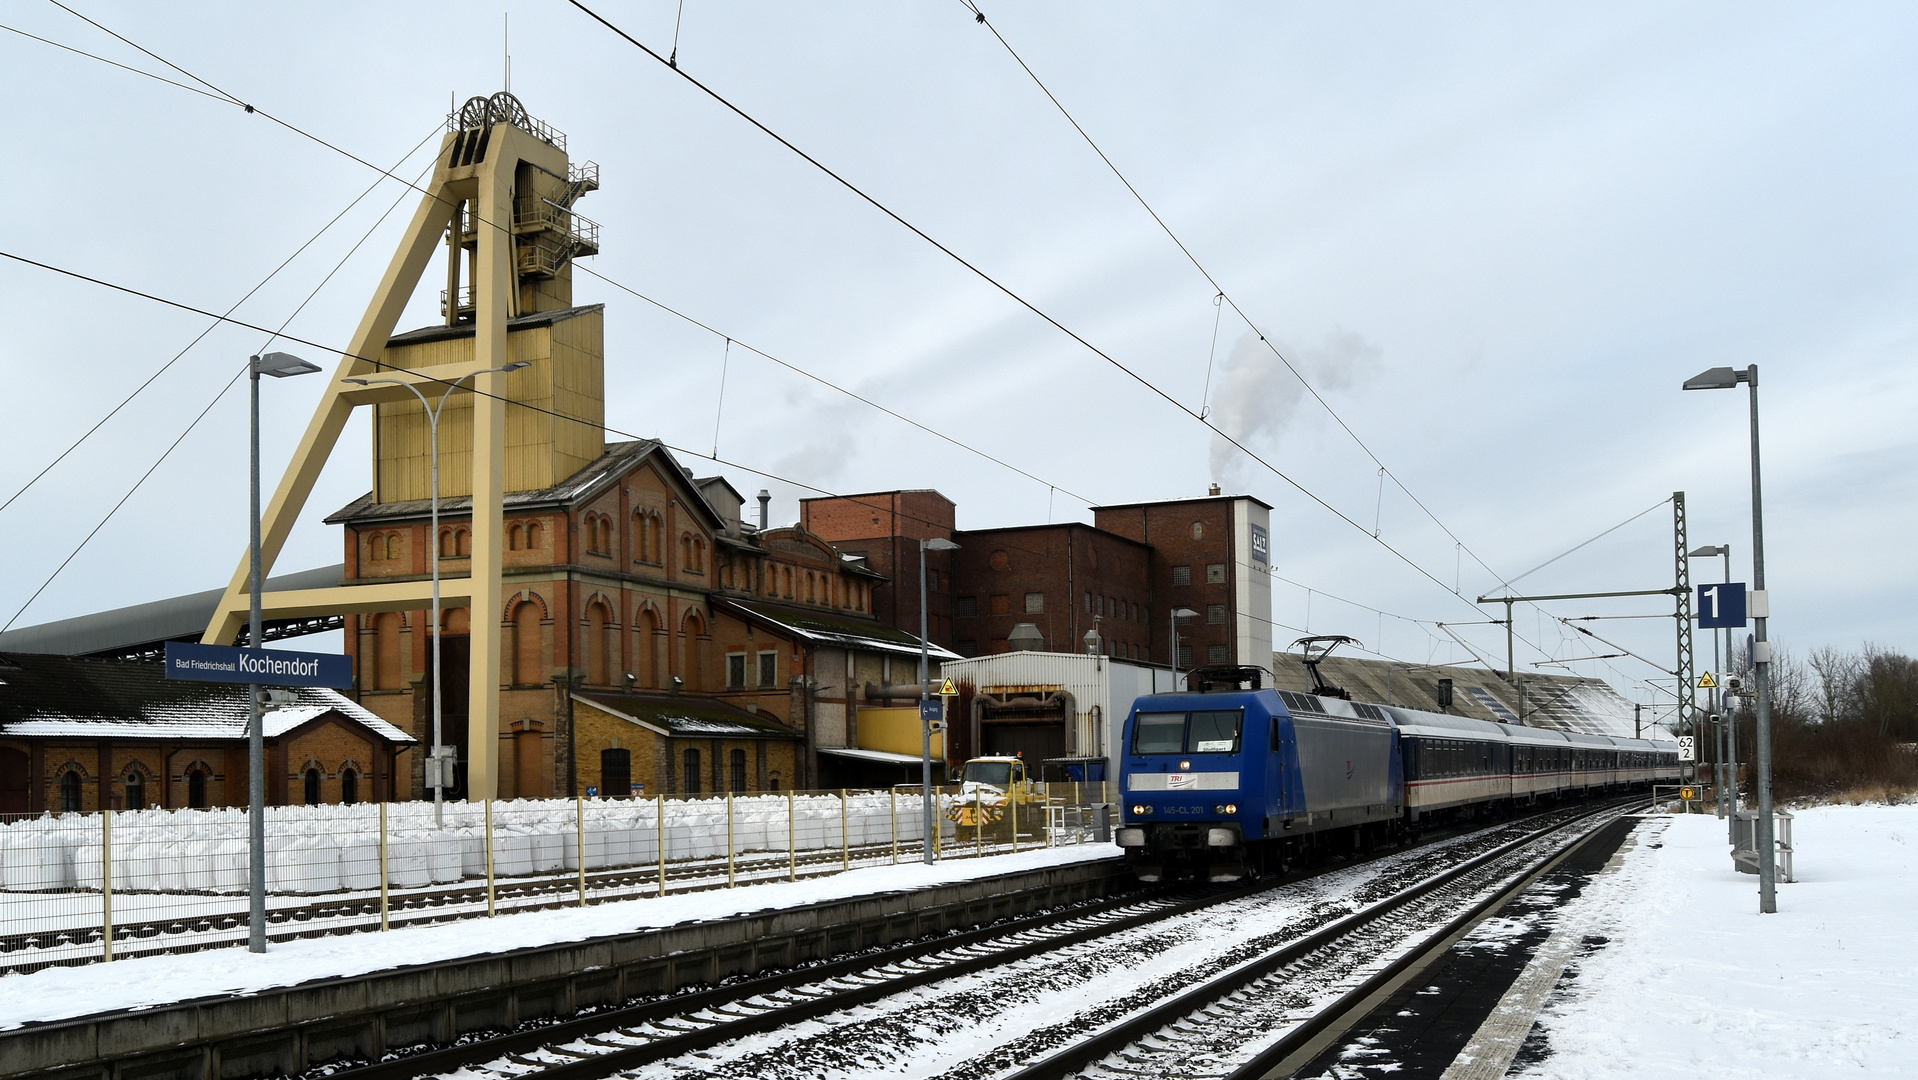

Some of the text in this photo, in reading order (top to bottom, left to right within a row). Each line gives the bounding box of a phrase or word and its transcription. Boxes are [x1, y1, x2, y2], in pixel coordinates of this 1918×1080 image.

[1703, 586, 1719, 618] 1
[175, 653, 319, 677] Bad Friedrichshall Kochendorf
[1678, 737, 1693, 748] 62
[1682, 748, 1690, 758] 2
[1163, 806, 1204, 814] 145-CL 201
